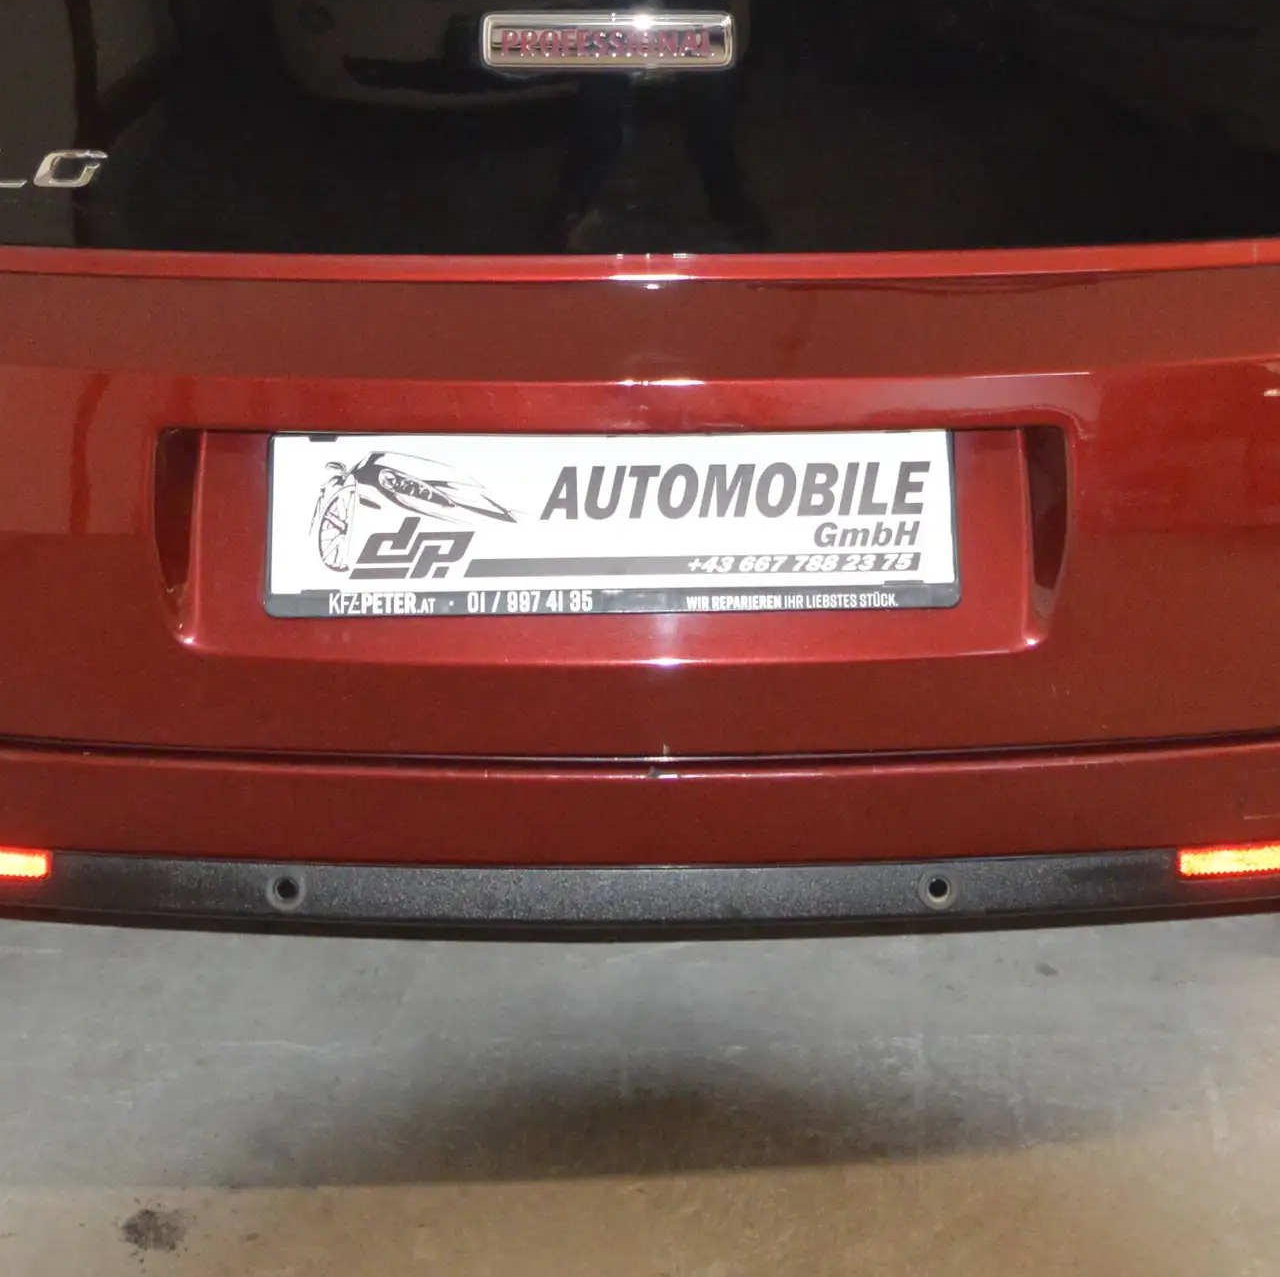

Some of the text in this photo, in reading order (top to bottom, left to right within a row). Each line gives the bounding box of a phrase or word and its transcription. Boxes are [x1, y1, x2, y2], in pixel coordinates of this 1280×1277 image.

[500, 28, 716, 58] PROFESSIONAL
[539, 461, 931, 520] AUTOMOBILE
[813, 521, 920, 547] GmbH
[687, 553, 913, 573] +43 667 788 23 75
[570, 590, 593, 612] 35
[686, 595, 709, 611] WIR
[784, 593, 803, 609] IHR
[806, 592, 858, 608] LIEBSTES
[860, 591, 899, 607] STÜCK.
